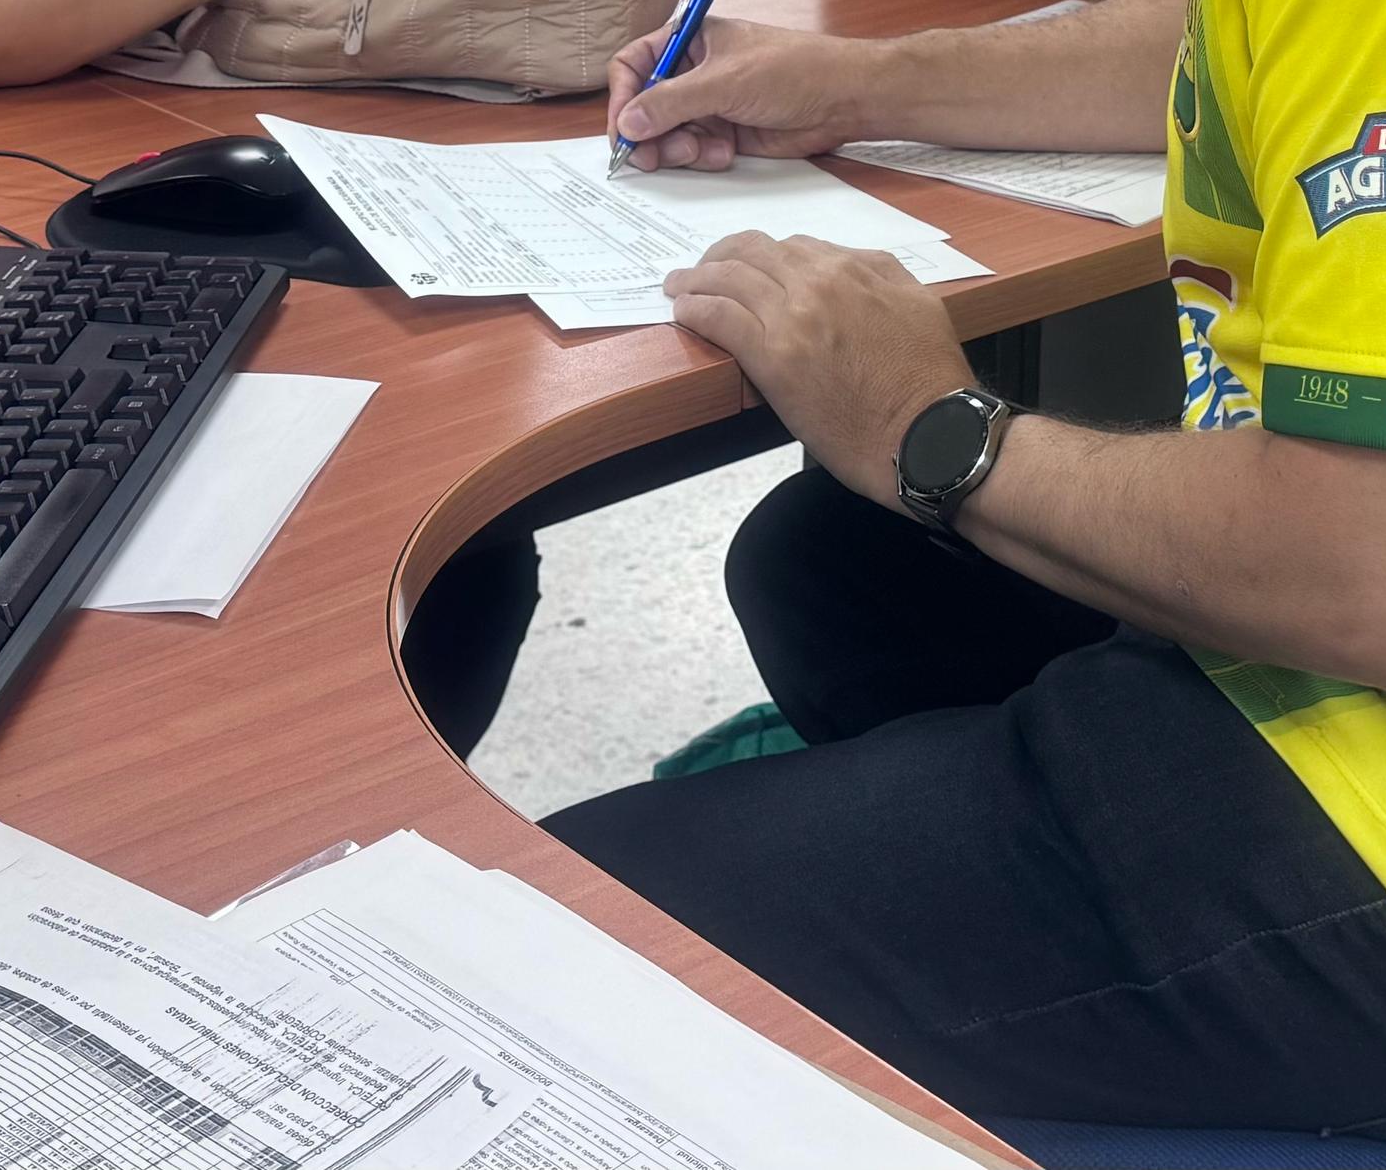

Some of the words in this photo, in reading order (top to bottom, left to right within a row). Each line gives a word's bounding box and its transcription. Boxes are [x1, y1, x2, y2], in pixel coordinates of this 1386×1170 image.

[1297, 374, 1350, 404] 1948
[64, 929, 80, 938] de
[36, 979, 54, 990] de
[49, 984, 71, 997] mes
[74, 998, 96, 1011] por
[233, 1000, 281, 1029] selecciona
[88, 1006, 139, 1037] presentada
[163, 1005, 227, 1045] TRIBUTARIAS
[133, 1032, 150, 1044] ya
[143, 1040, 195, 1073] declaración
[219, 1041, 303, 1092] DECLARACIONES
[292, 1050, 315, 1063] por
[320, 1052, 338, 1063] de
[494, 1050, 553, 1087] DOCUMENTOS
[308, 1059, 350, 1085] Ingresar
[335, 1060, 390, 1092] declaración
[206, 1080, 255, 1111] corrección
[249, 1107, 288, 1131] realizar
[283, 1109, 314, 1128] paso
[294, 1088, 367, 1129] CORRECCIÓN
[545, 1104, 573, 1122] Vicente
[281, 1127, 315, 1148] desea
[620, 1115, 667, 1144] Descargar
[597, 1137, 631, 1159] Asignado
